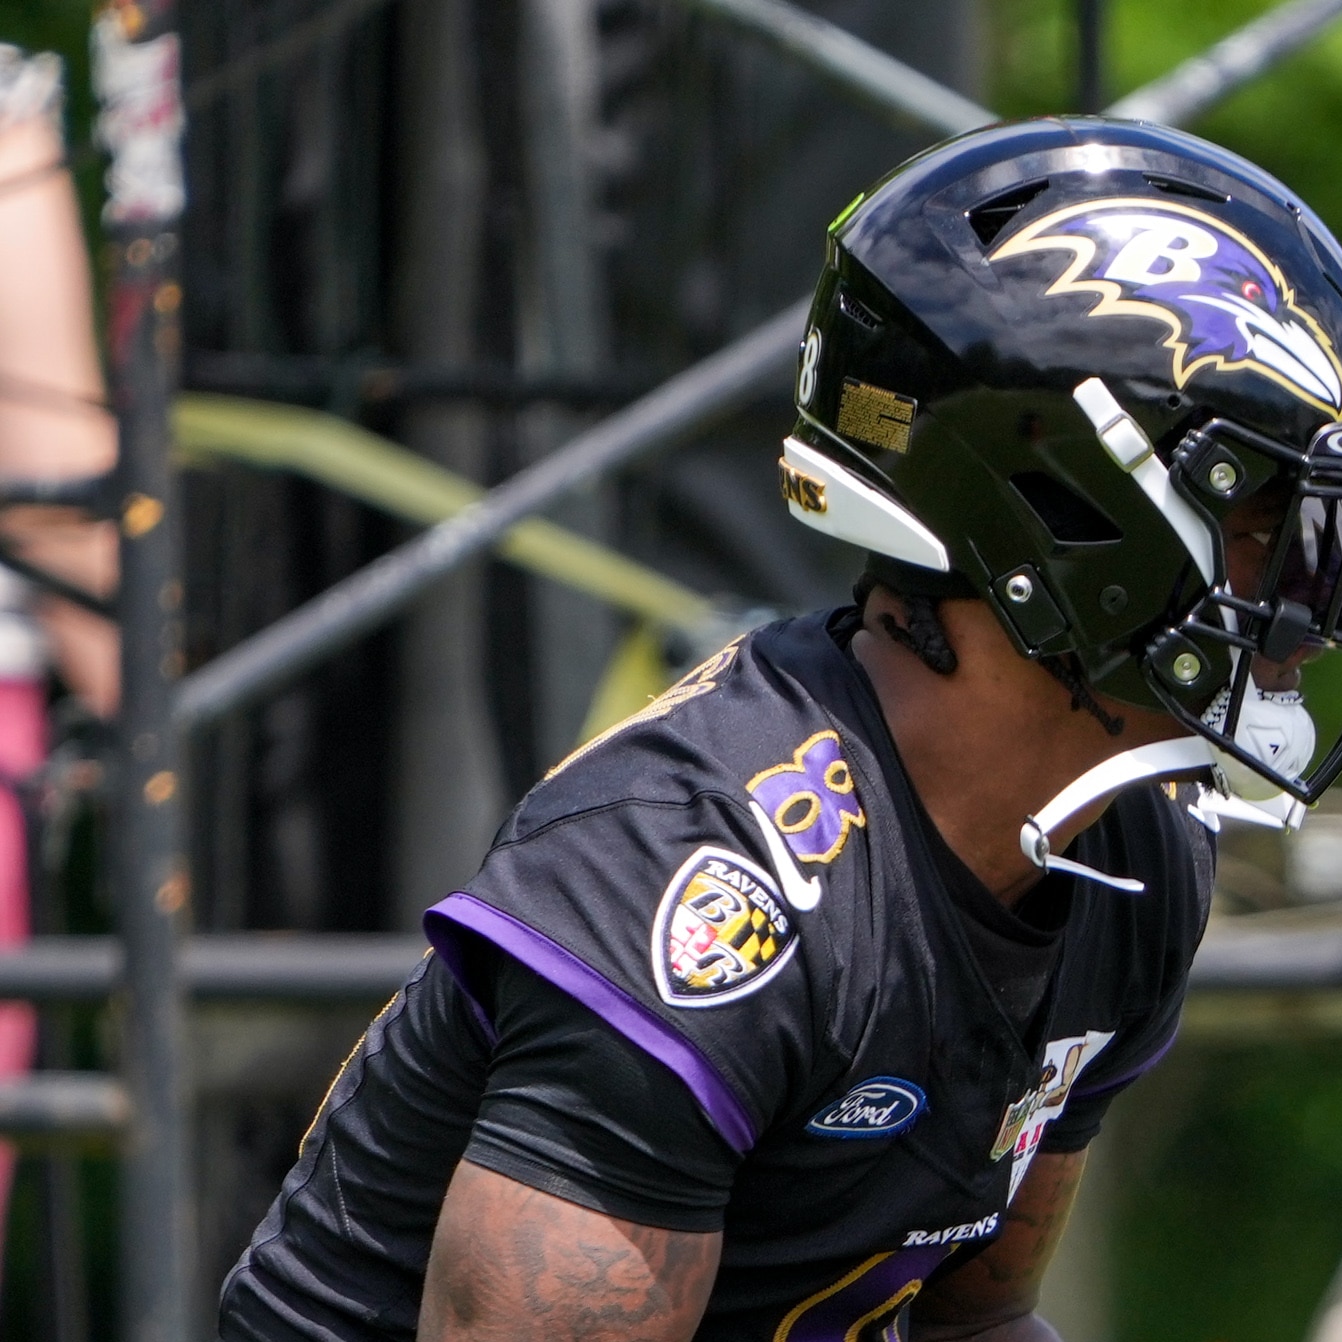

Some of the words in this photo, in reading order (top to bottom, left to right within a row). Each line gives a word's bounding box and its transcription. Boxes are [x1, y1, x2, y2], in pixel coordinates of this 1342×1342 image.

[1086, 214, 1219, 286] B
[798, 326, 823, 406] 8
[703, 860, 790, 935] RAVENS
[822, 1091, 900, 1126] Ford
[902, 1212, 1000, 1247] RAVENS
